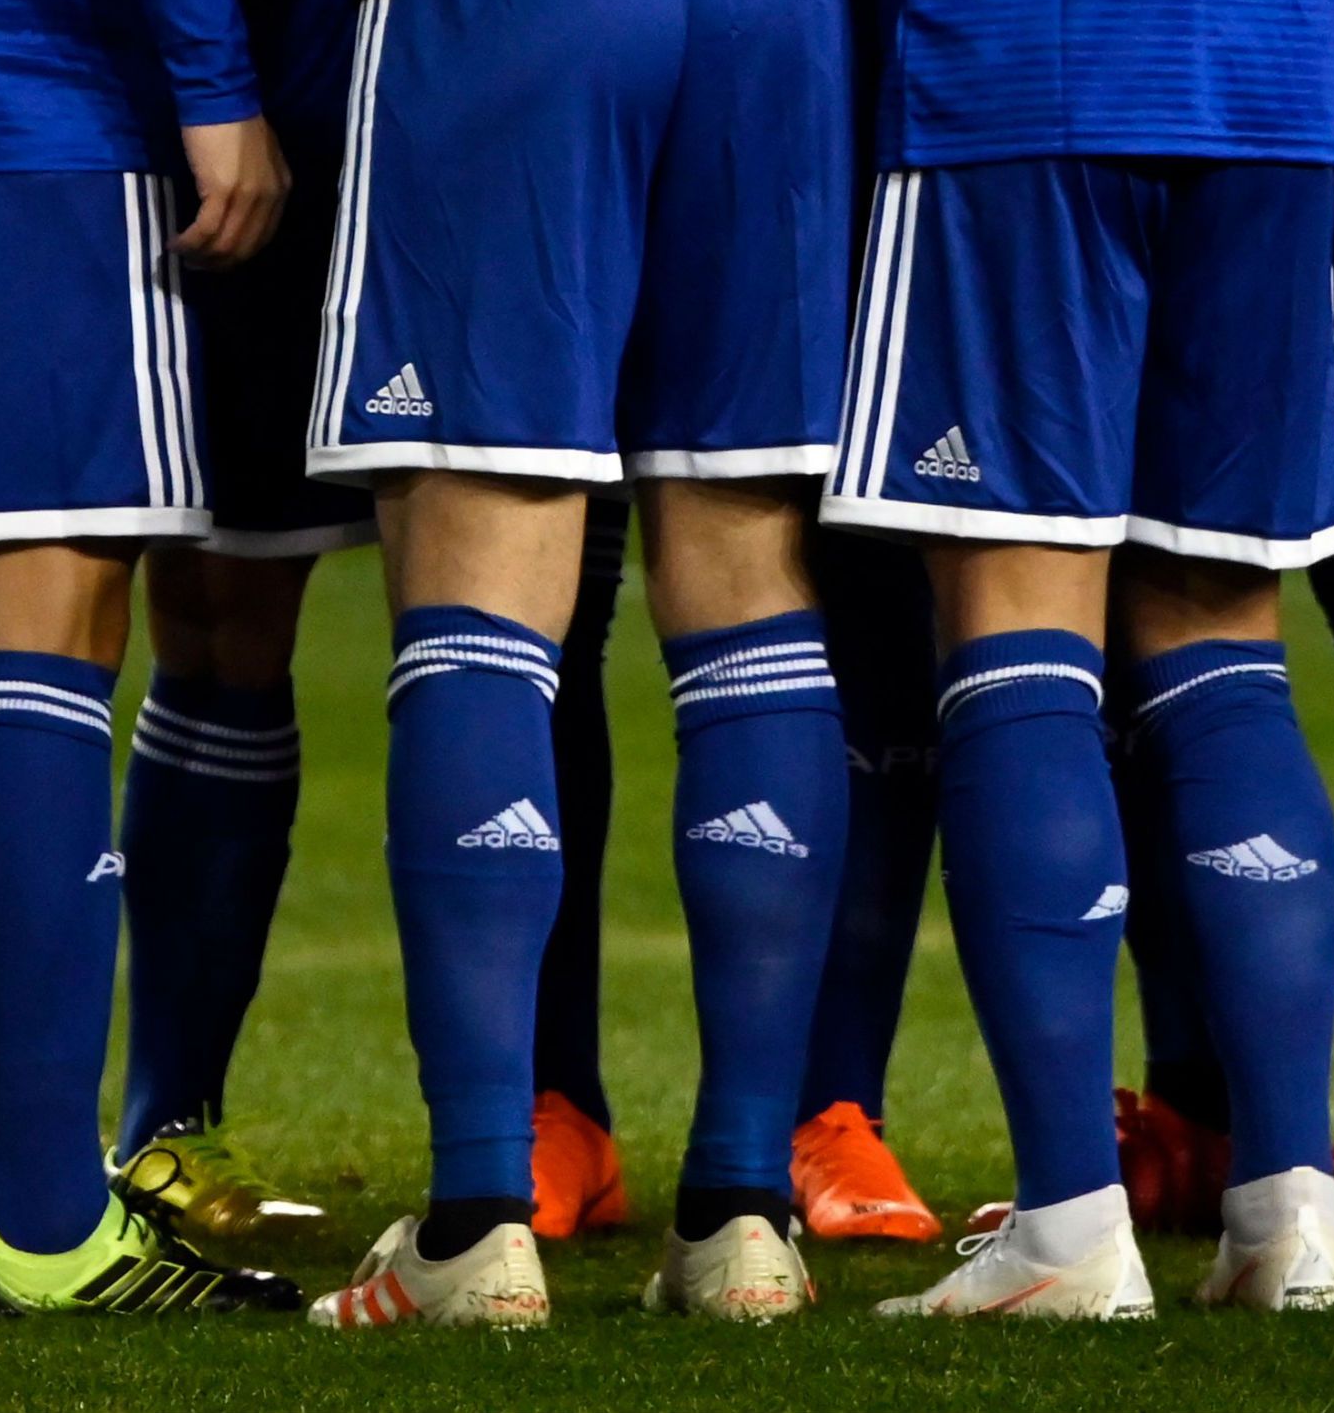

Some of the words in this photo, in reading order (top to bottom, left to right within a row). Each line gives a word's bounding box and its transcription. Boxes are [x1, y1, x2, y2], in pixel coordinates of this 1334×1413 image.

[365, 393, 434, 417] adidas
[913, 457, 983, 483] adidas
[456, 829, 560, 852] adidas
[685, 824, 810, 859] adidas
[1186, 851, 1318, 882] adidas
